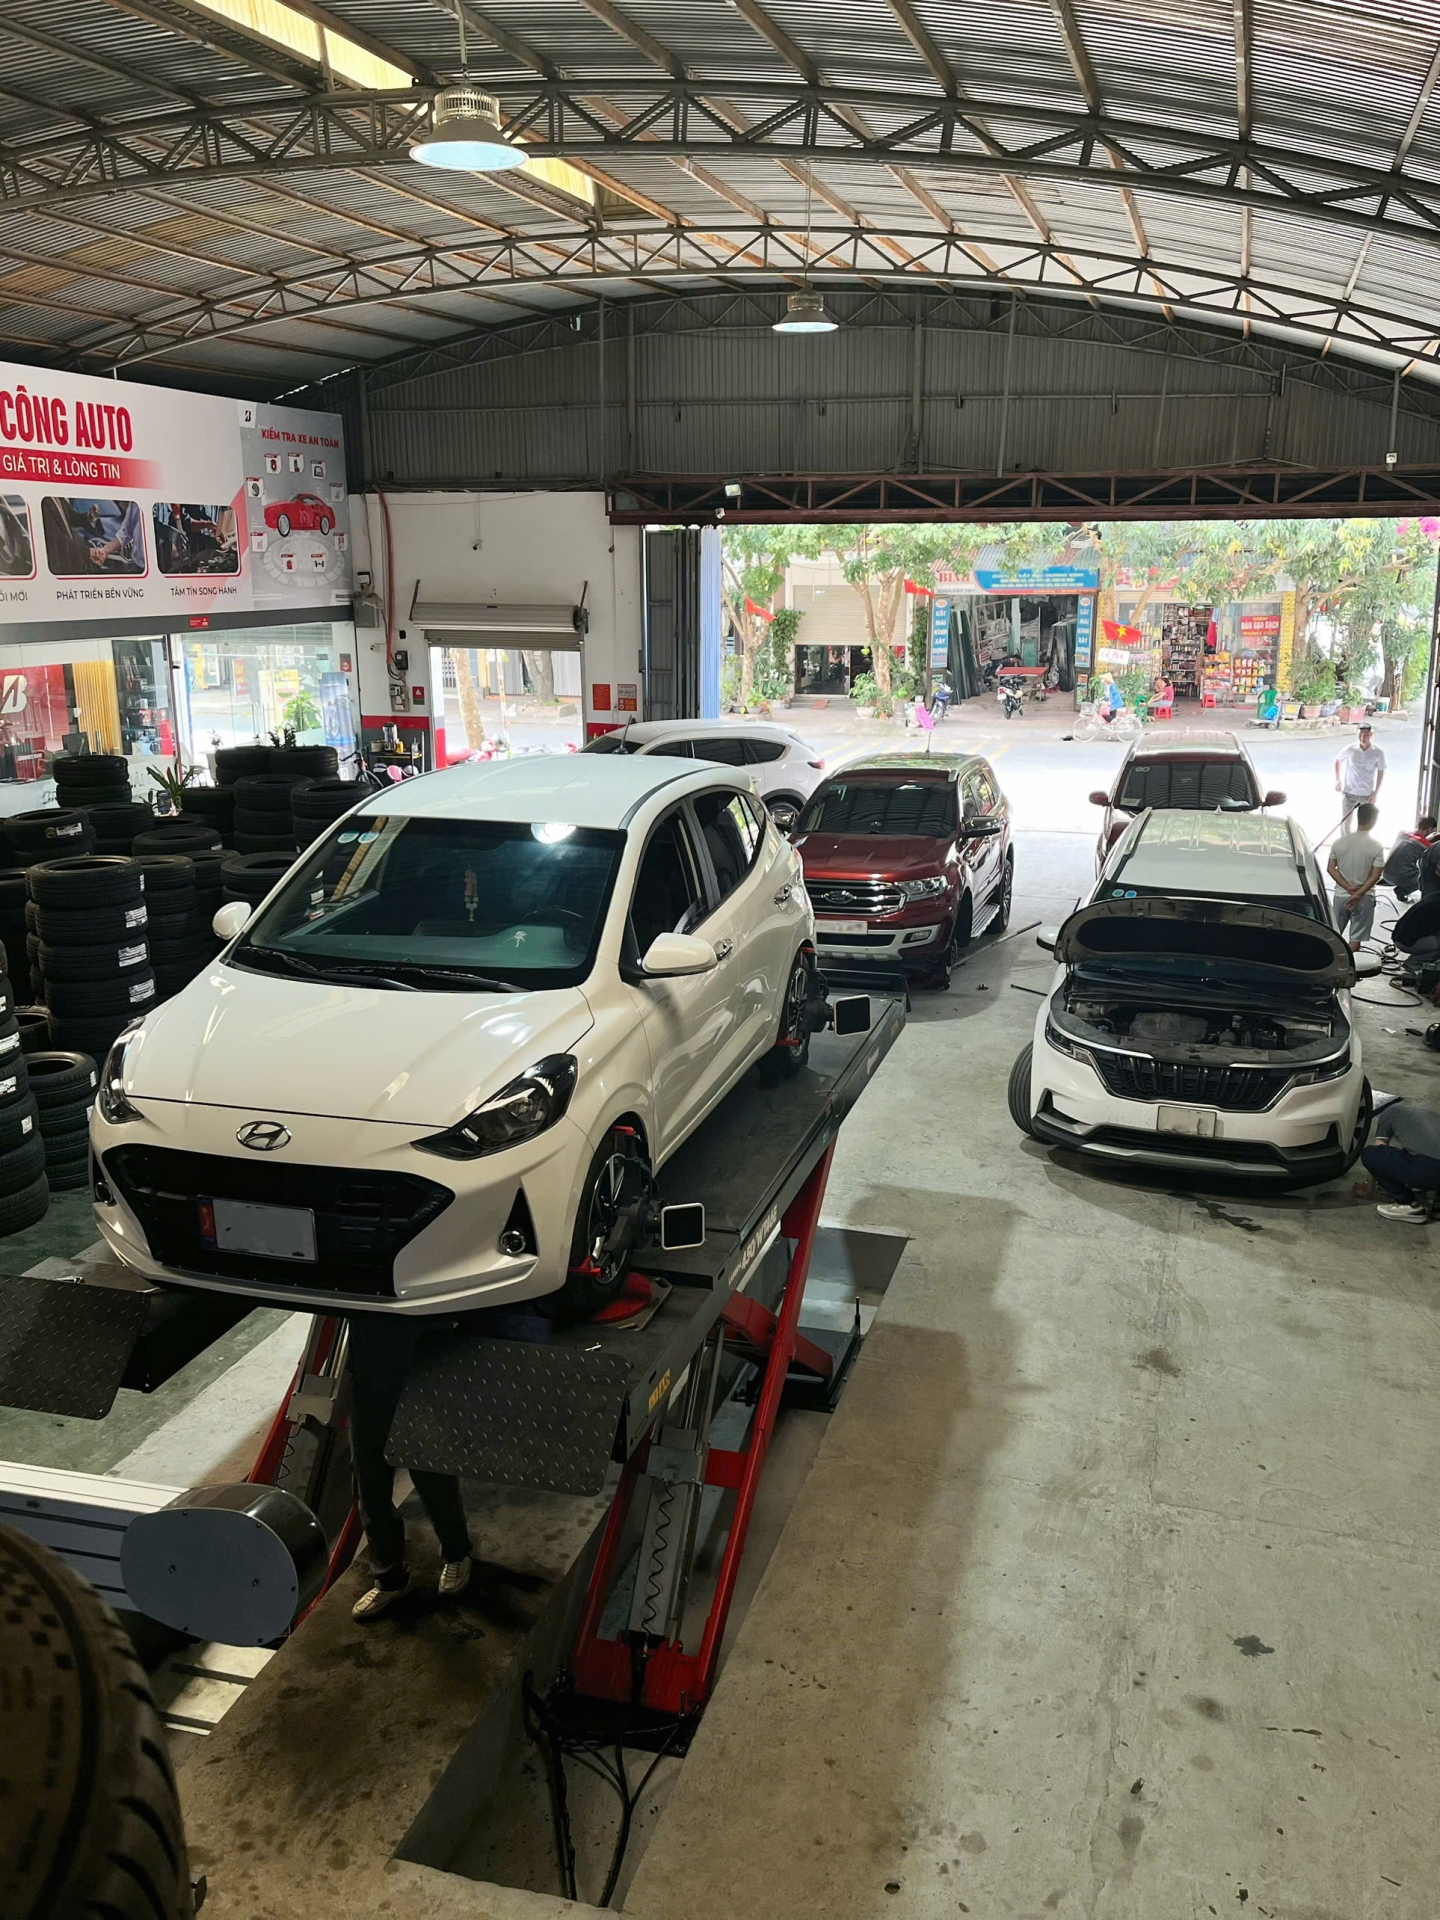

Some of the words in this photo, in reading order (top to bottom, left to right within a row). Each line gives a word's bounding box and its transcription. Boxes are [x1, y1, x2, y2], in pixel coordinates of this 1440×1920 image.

[0, 385, 69, 446] CÔNG
[75, 401, 133, 452] AUTO
[281, 432, 296, 442] TRA
[297, 434, 307, 444] XE
[308, 436, 319, 446] AN
[320, 436, 339, 448] TOÀN
[3, 452, 27, 473] GIÁ
[28, 457, 50, 477] TRỊ
[53, 459, 62, 475] &
[64, 457, 98, 478] LÒNG
[100, 463, 121, 479] TIN
[56, 588, 78, 600] PHÁT
[121, 587, 144, 598] VỮNG
[170, 585, 185, 596] TÂM
[198, 586, 218, 596] SONG
